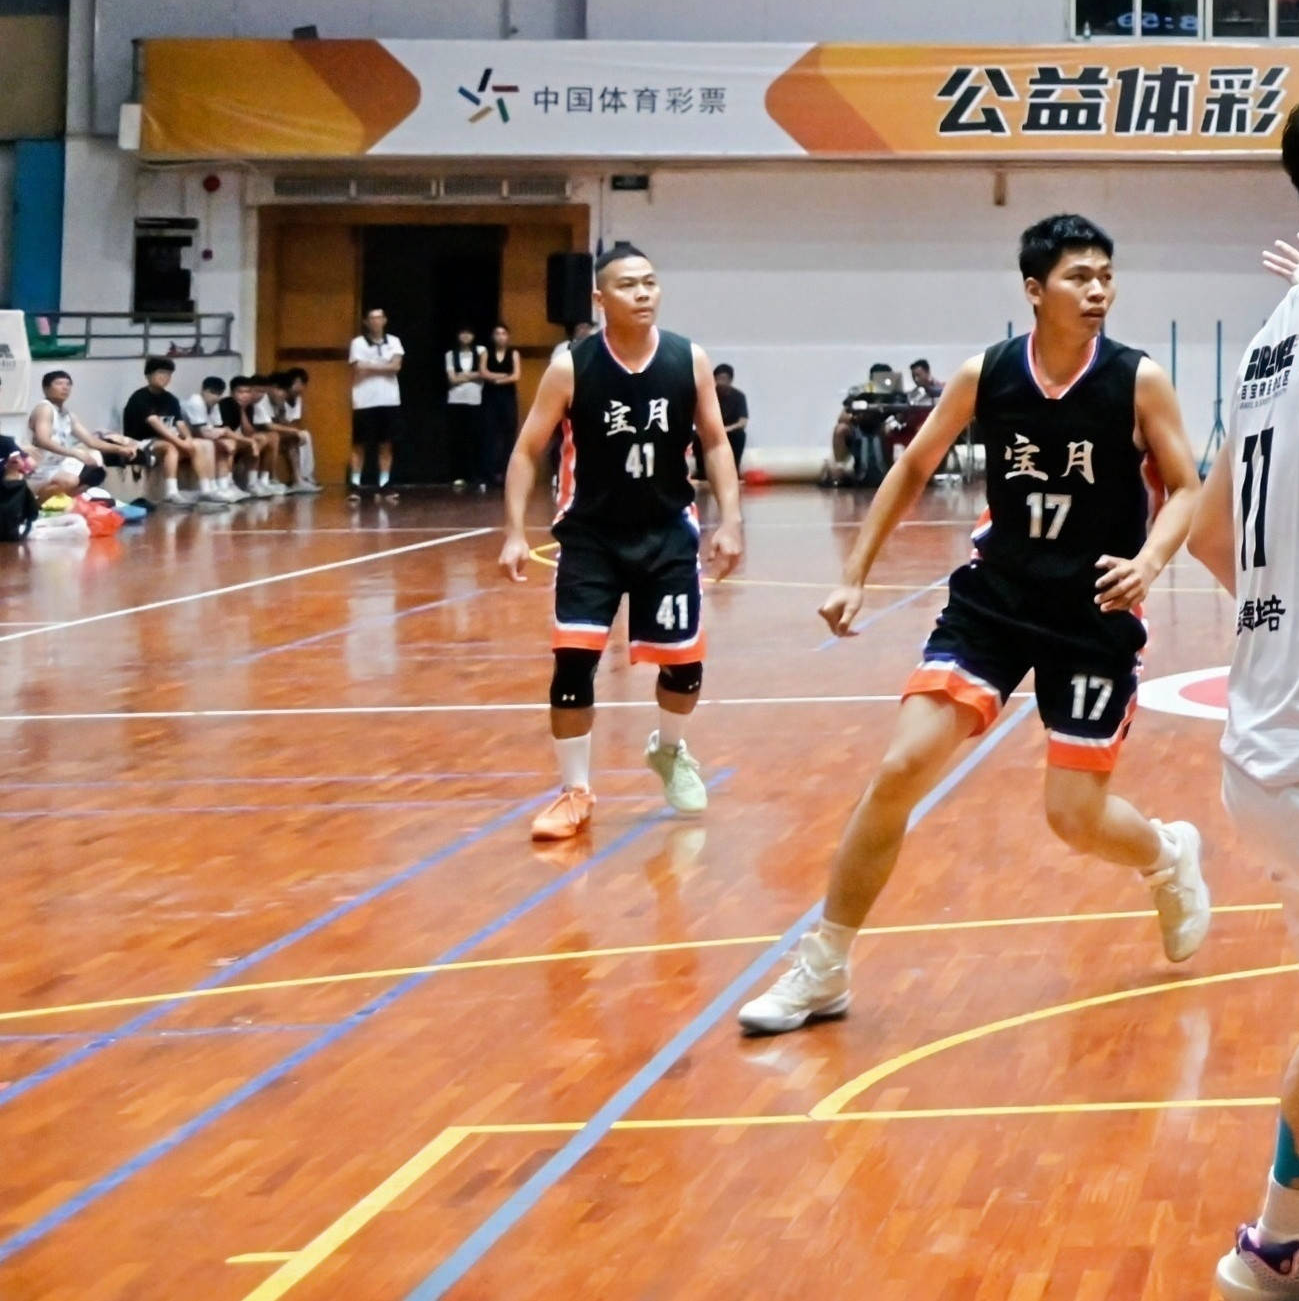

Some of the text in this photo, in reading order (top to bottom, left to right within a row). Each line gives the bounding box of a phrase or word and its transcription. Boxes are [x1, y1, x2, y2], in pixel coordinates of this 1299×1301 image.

[532, 86, 727, 115] 中国体育彩票
[935, 64, 1290, 137] 公益体彩
[603, 398, 671, 436] 宝月
[625, 443, 655, 479] 41
[1005, 434, 1095, 485] 宝月
[1026, 493, 1071, 539] 17
[656, 594, 688, 630] 41
[1070, 674, 1113, 720] 17
